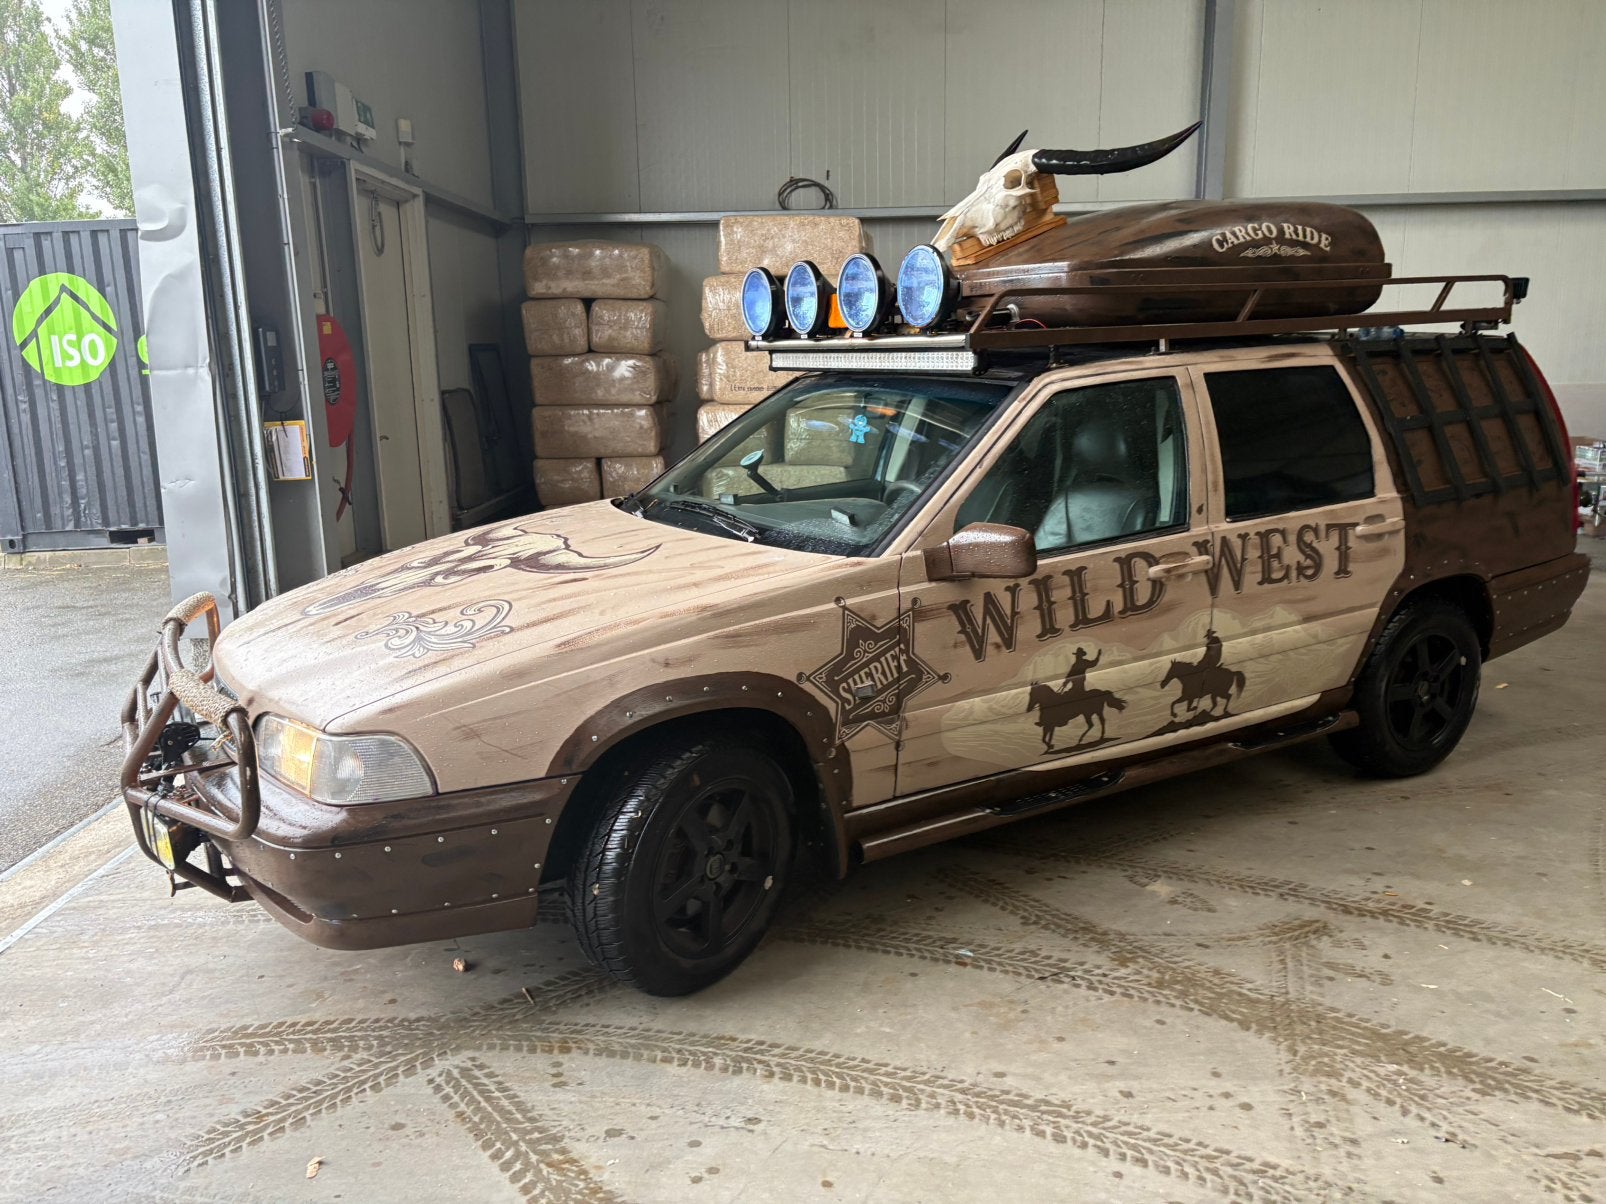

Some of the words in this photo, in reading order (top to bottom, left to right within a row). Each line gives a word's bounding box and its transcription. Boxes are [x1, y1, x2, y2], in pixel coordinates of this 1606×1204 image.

[1211, 222, 1277, 253] CARGO
[1281, 223, 1332, 251] RIDE
[50, 332, 105, 367] ISO
[947, 551, 1167, 663] WILD
[1191, 522, 1360, 599] WEST
